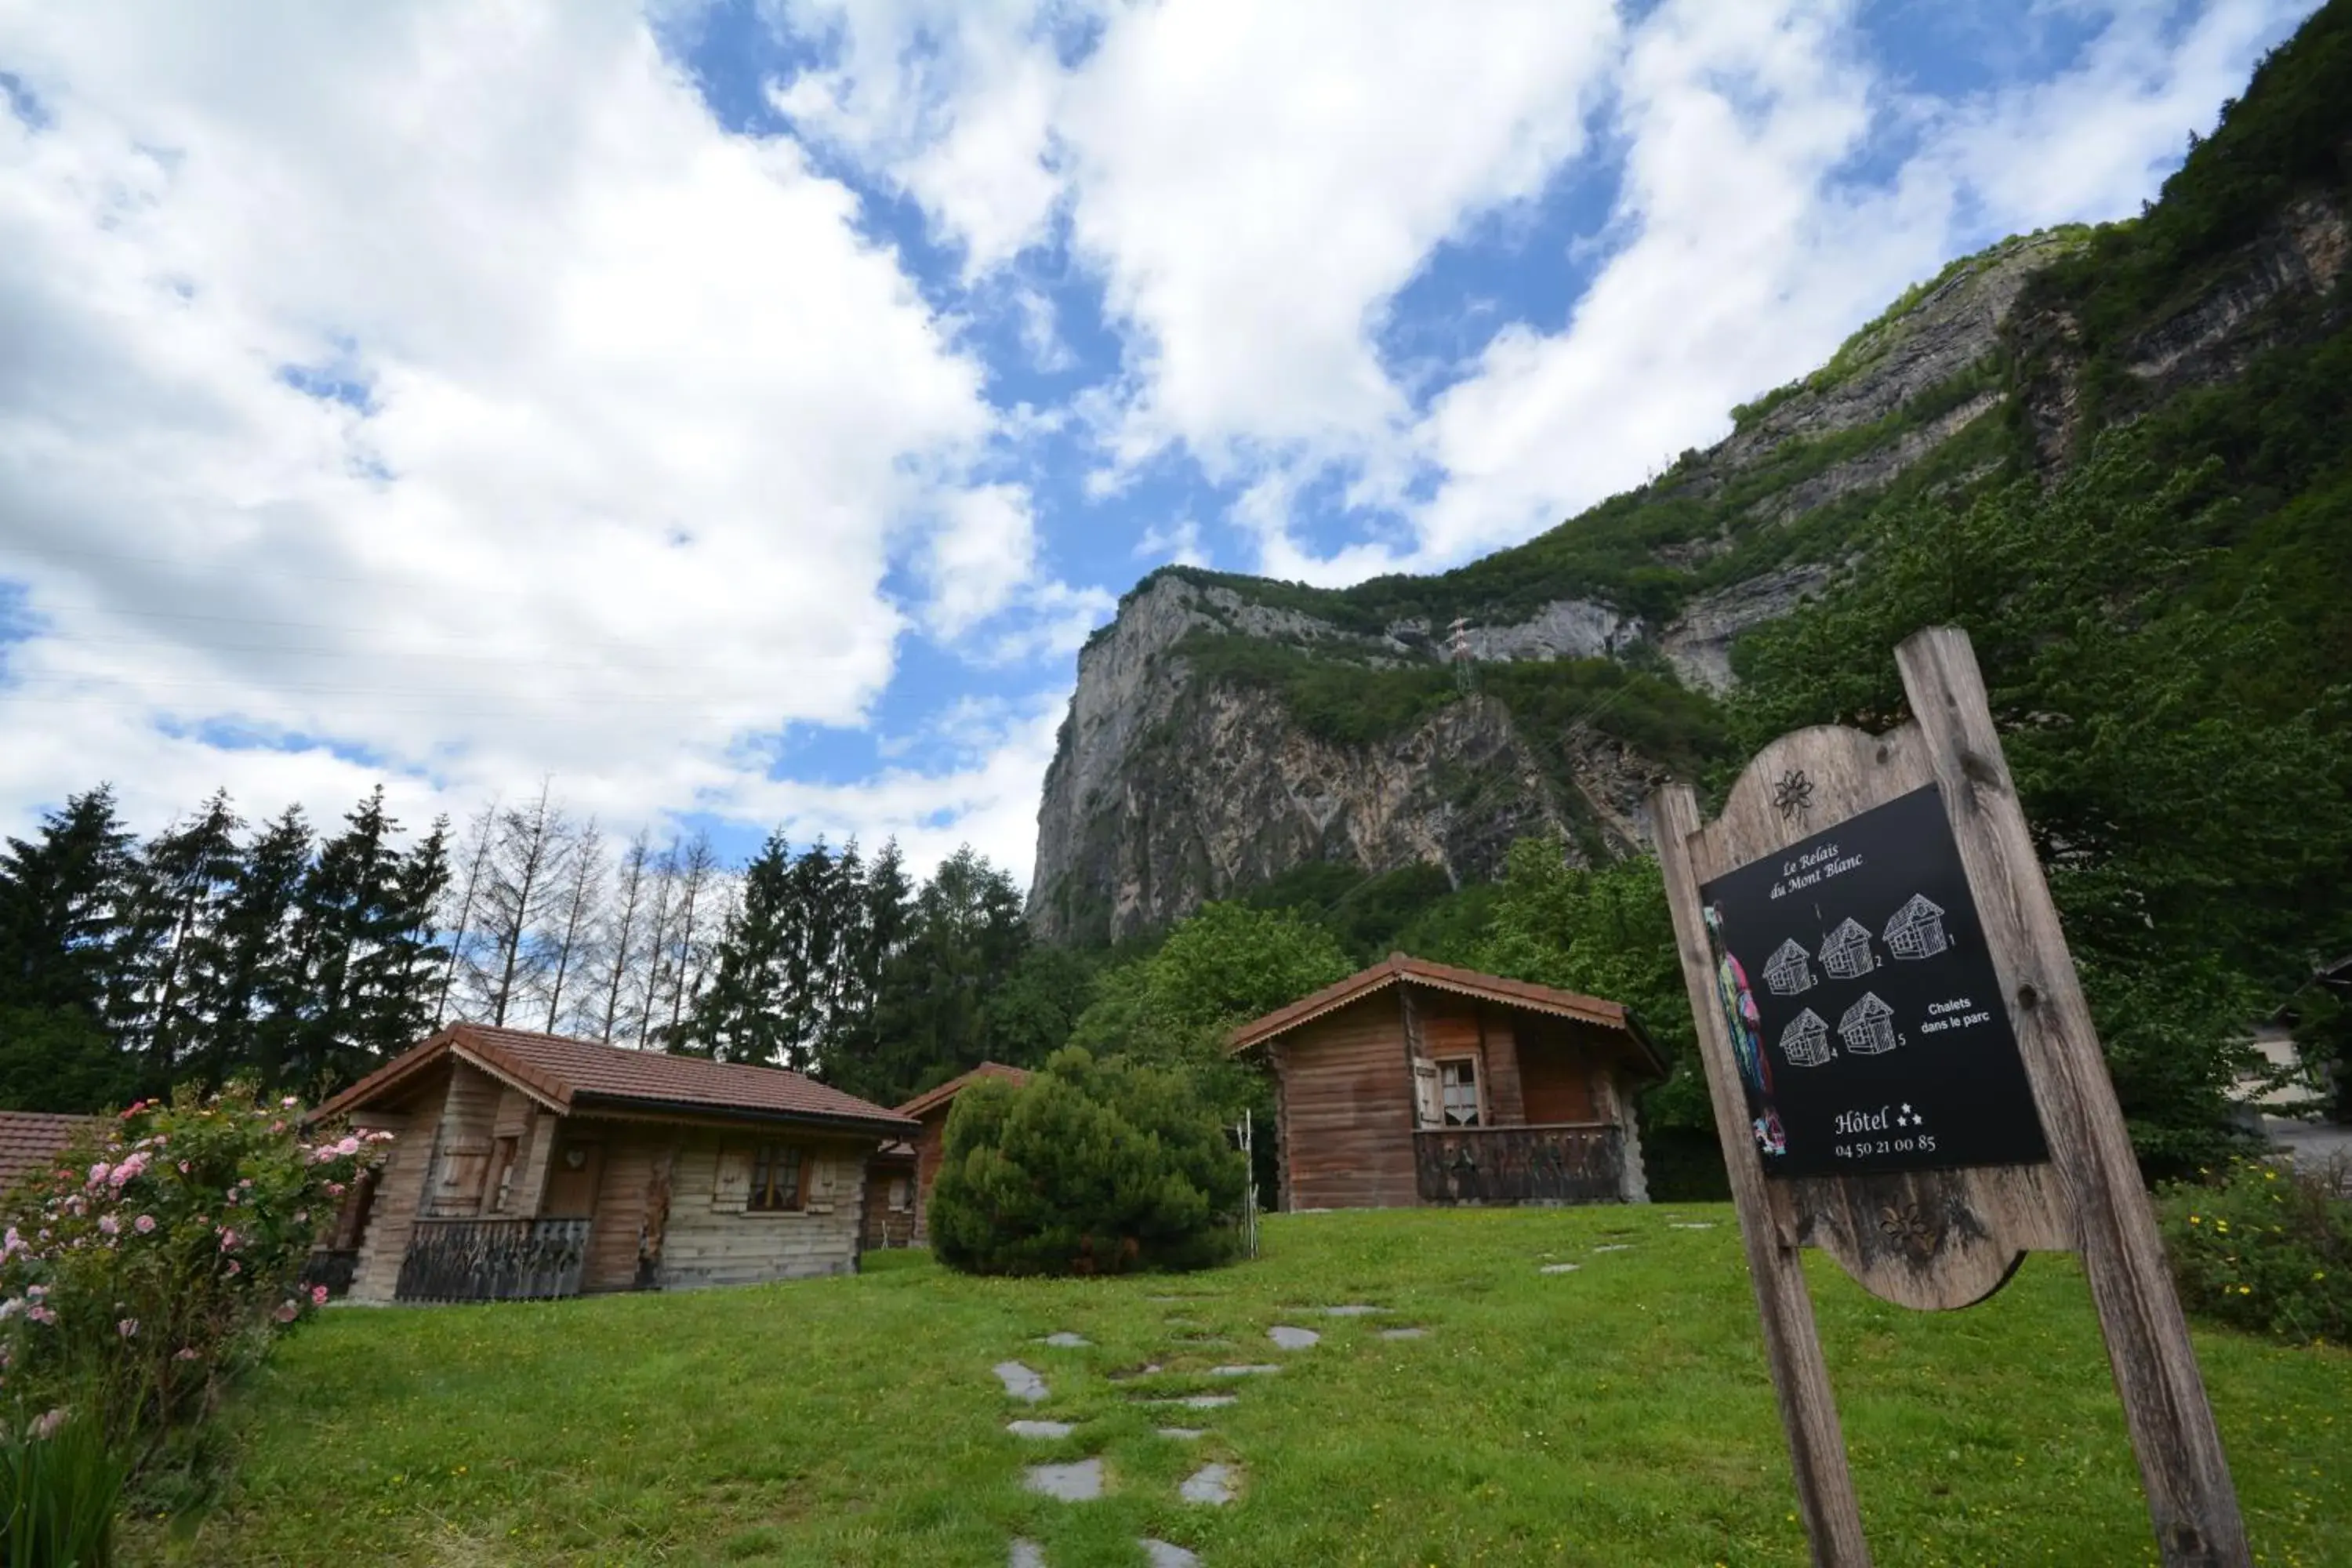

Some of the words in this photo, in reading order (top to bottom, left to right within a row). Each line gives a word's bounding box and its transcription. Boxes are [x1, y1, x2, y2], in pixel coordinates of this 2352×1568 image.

[1784, 862, 1796, 877] Le
[1799, 844, 1838, 869] Relais
[1770, 882, 1786, 899] du
[1788, 869, 1821, 893] Mont
[1824, 854, 1863, 877] Blanc
[1875, 956, 1883, 967] 2
[1811, 975, 1818, 985] 3
[1929, 998, 1971, 1015] Chalets
[1922, 1021, 1948, 1033] dans
[1950, 1017, 1961, 1028] le
[1963, 1011, 1990, 1028] parc
[1898, 1033, 1906, 1046] 5
[1831, 1047, 1838, 1058] 4
[1835, 1105, 1889, 1134] Hôtel
[1835, 1145, 1853, 1158] 04
[1856, 1142, 1872, 1158] 50
[1877, 1141, 1890, 1153] 21
[1895, 1139, 1914, 1152] 00
[1918, 1134, 1936, 1152] 85
